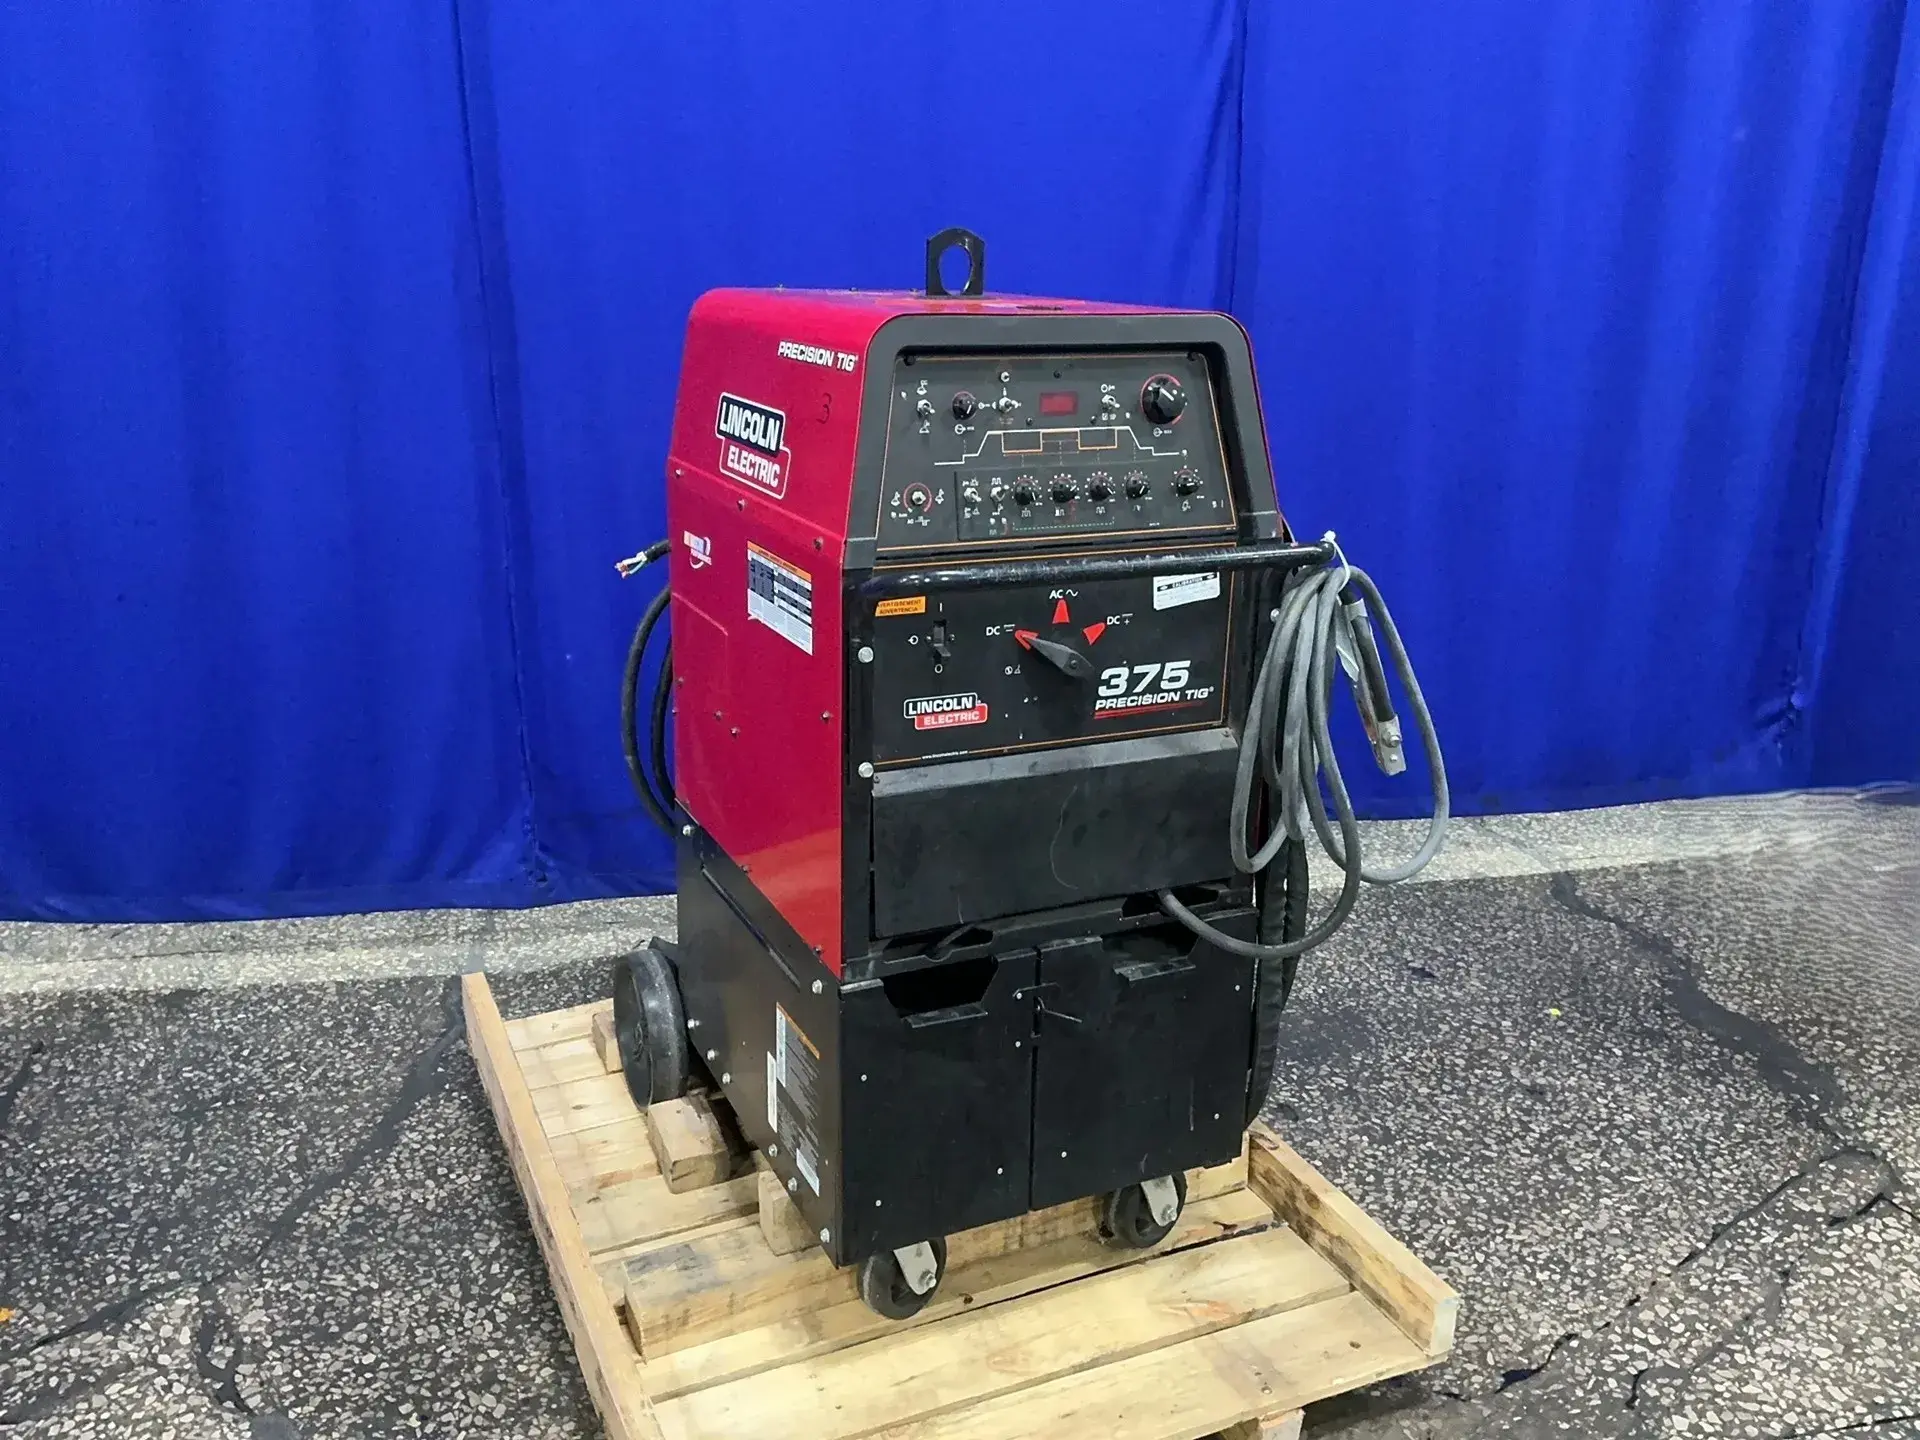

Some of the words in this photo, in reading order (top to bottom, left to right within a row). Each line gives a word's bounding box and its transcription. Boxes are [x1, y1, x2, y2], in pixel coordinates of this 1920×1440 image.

[777, 341, 835, 367] PRECISION
[816, 392, 832, 424] 3
[719, 401, 780, 451] LINCOLN
[726, 445, 781, 488] ELECTRIC
[1049, 588, 1064, 599] AC
[1106, 615, 1121, 626] DC
[985, 625, 1001, 637] DC
[1097, 660, 1192, 697] 375
[908, 696, 973, 715] LINCOLN
[1095, 691, 1181, 711] PRECISION
[923, 710, 980, 726] ELECTRIC
